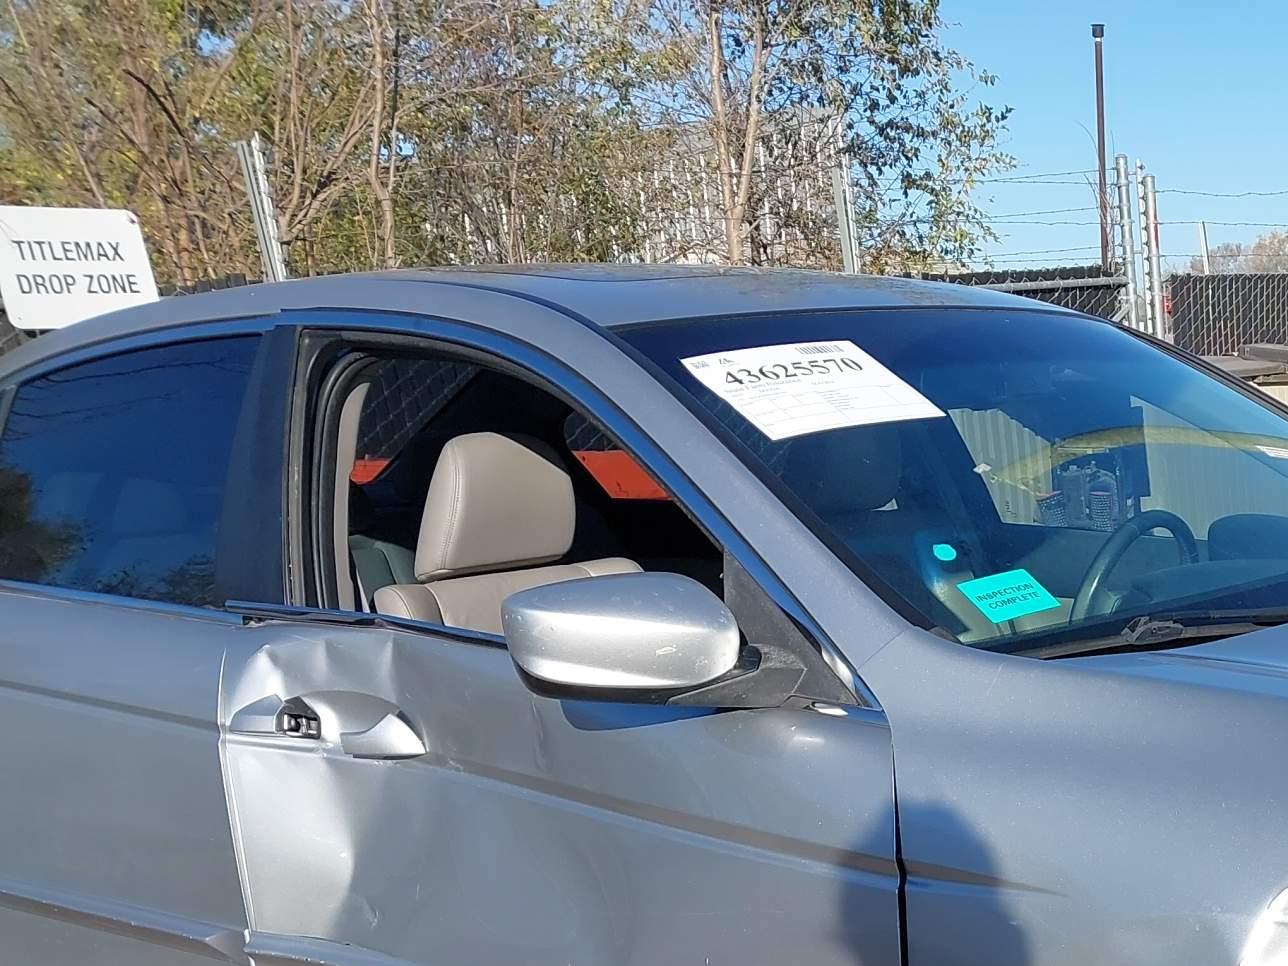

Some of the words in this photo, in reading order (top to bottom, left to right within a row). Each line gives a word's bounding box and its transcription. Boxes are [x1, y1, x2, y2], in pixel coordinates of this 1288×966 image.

[11, 240, 125, 262] TITLEMAX
[16, 274, 76, 294] DROP
[83, 274, 141, 294] ZONE
[725, 357, 863, 386] 43625570
[976, 582, 1034, 602] INSPECTION
[988, 592, 1041, 610] COMPLETE
